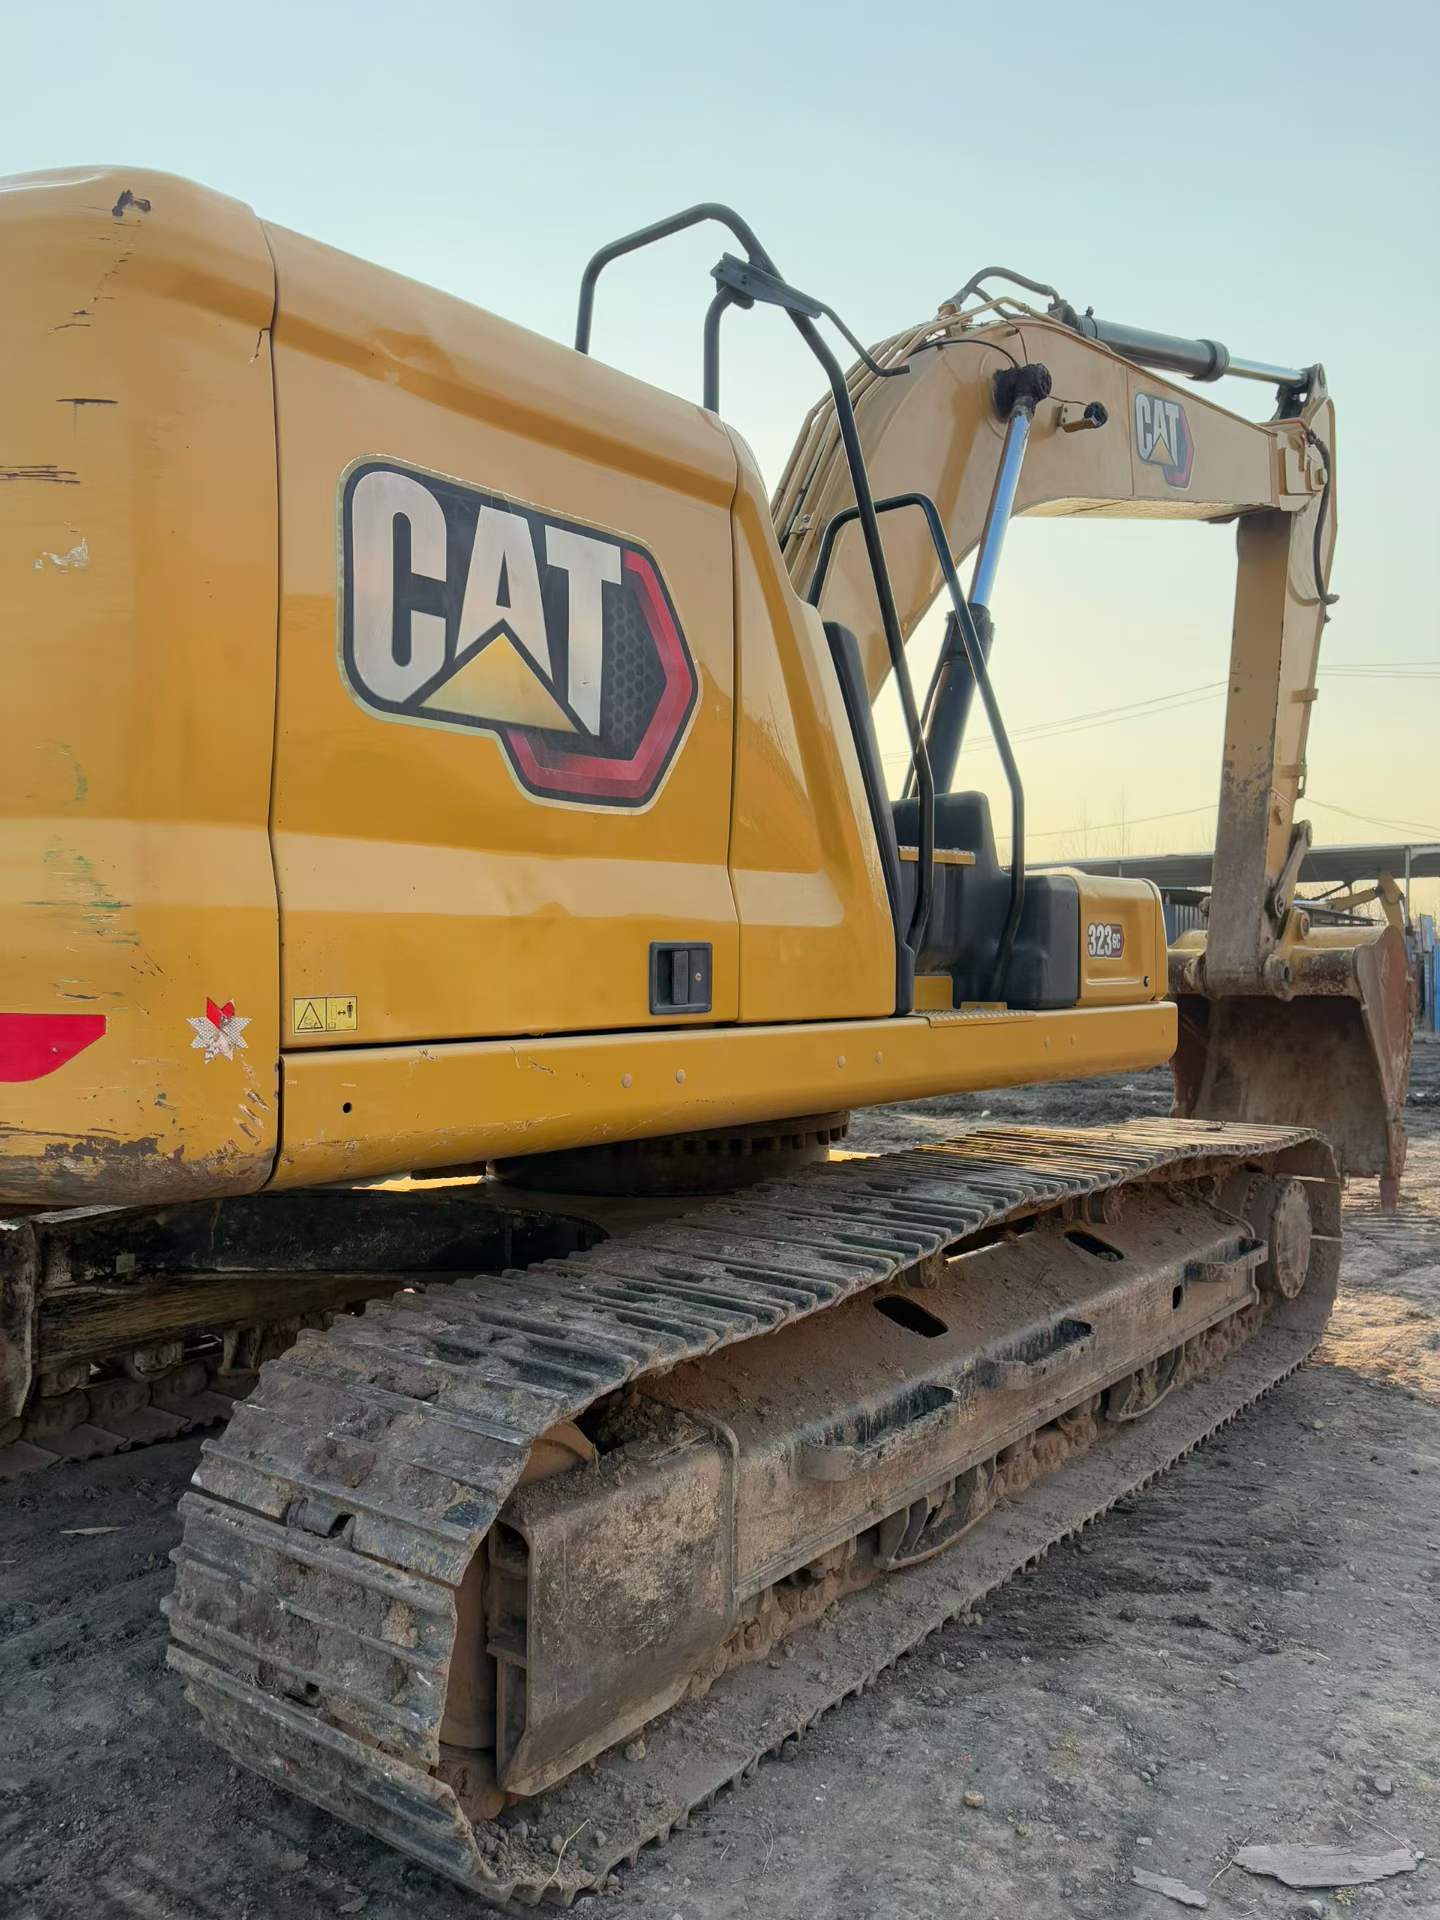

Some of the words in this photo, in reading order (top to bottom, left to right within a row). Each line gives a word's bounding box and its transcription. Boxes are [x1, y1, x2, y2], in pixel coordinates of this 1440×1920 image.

[1135, 393, 1180, 467] CAT
[351, 470, 622, 737] CAT
[1088, 923, 1112, 956] 323
